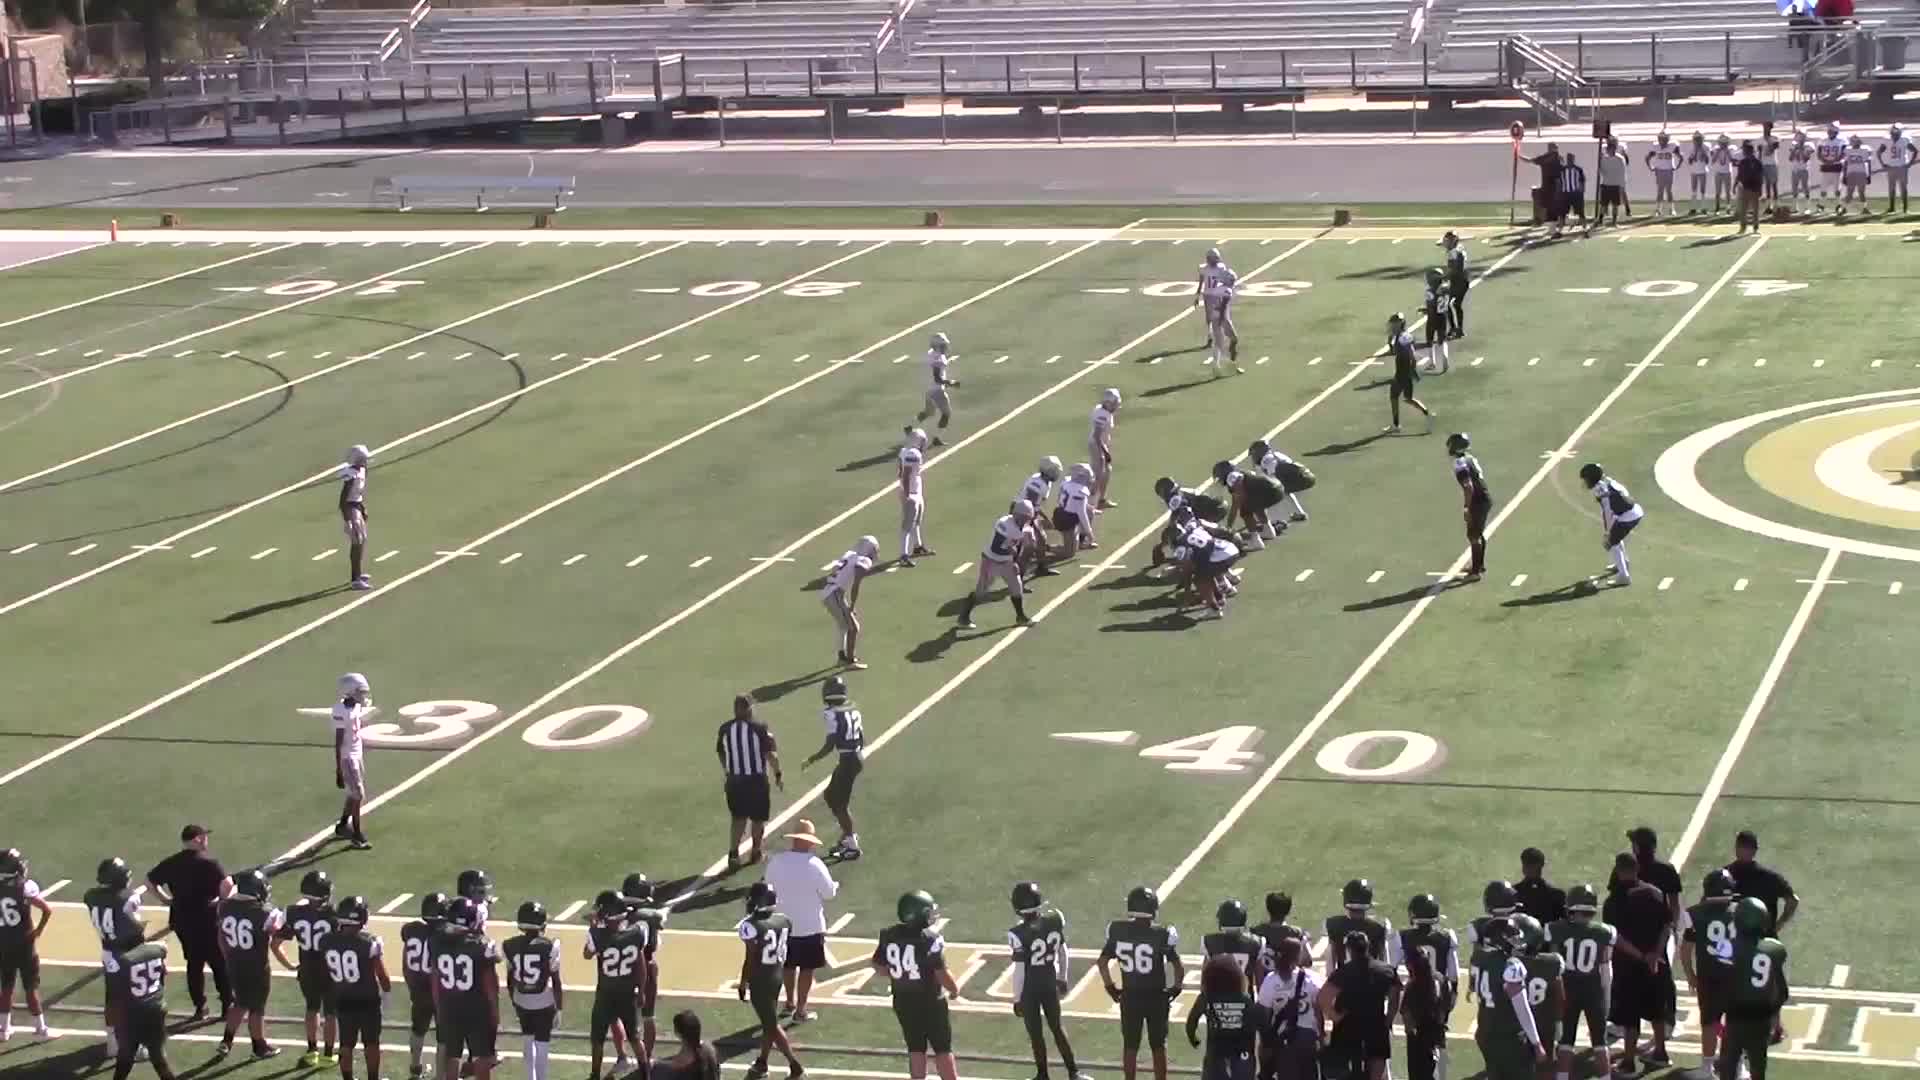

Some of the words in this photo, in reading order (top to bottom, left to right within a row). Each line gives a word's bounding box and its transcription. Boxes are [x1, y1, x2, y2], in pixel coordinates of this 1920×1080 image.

[845, 710, 863, 741] 12
[221, 915, 254, 950] 96
[761, 927, 788, 965] 24
[325, 949, 360, 983] 98
[437, 953, 474, 991] 93
[512, 953, 541, 985] 15
[602, 945, 639, 977] 22
[886, 943, 921, 980] 94
[1116, 941, 1153, 974] 56
[1563, 937, 1597, 972] 10
[1751, 953, 1772, 988] 9
[130, 958, 163, 997] 55
